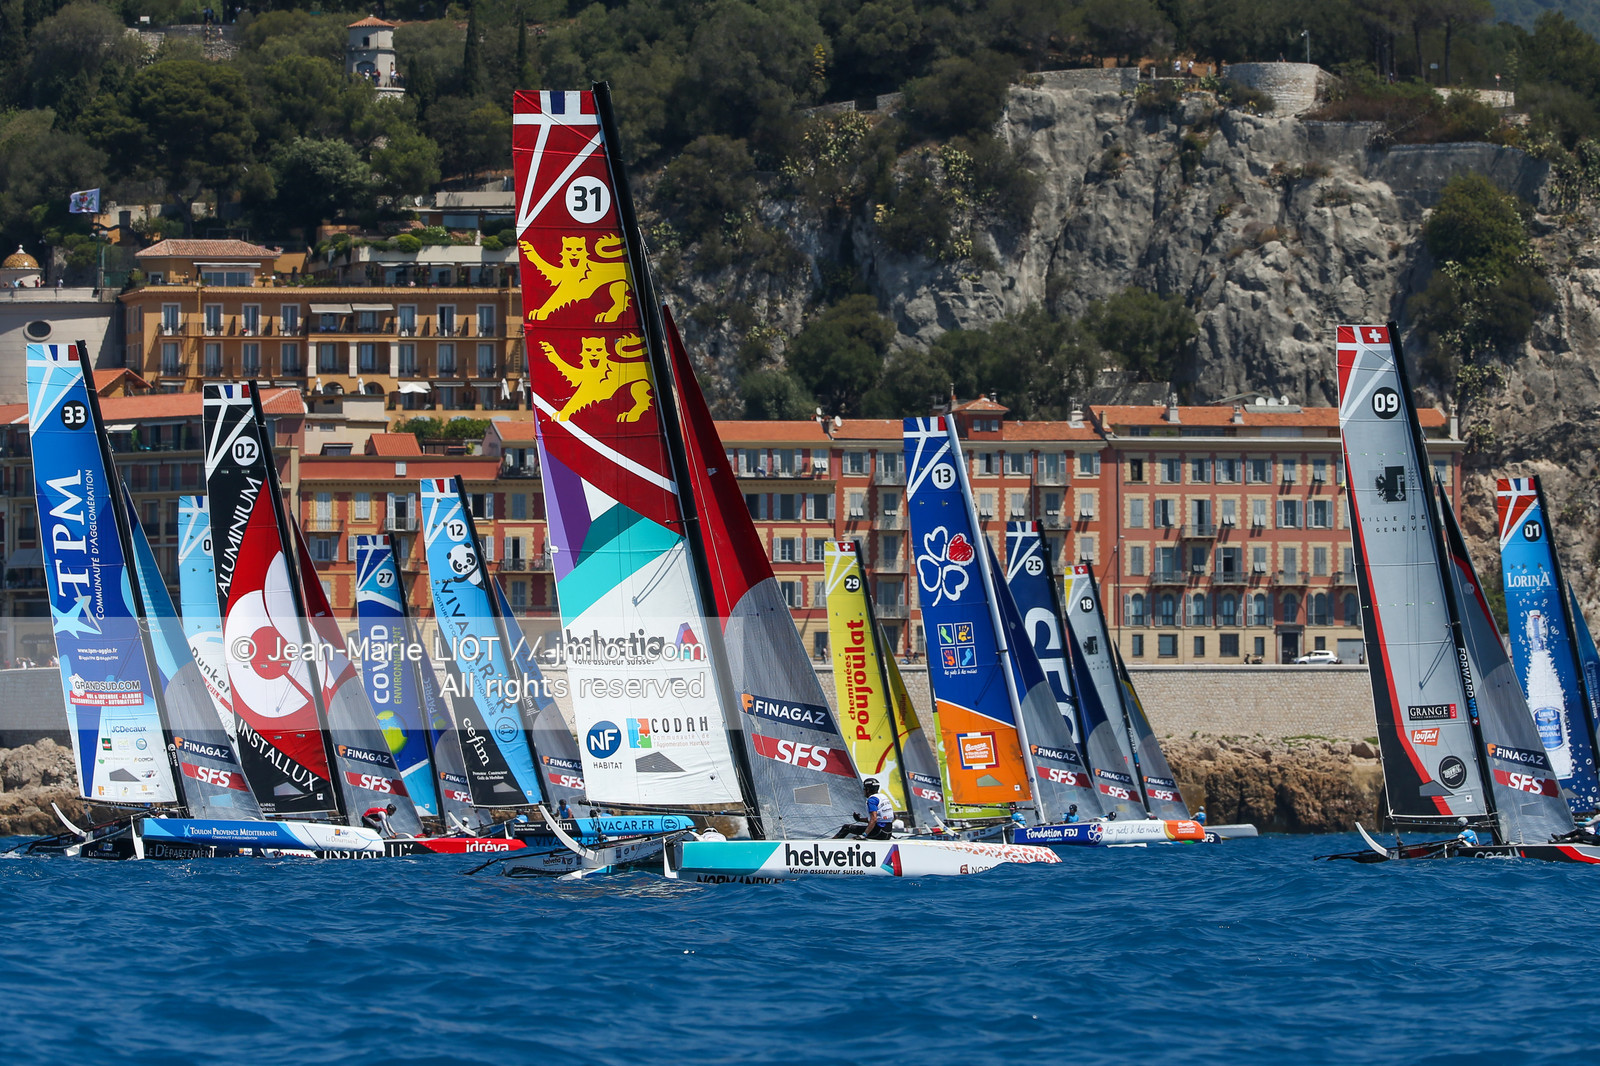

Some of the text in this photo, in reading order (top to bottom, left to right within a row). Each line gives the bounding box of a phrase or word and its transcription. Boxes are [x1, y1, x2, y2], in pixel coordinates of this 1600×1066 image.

[573, 186, 601, 211] 31
[1374, 393, 1399, 412] 09
[64, 406, 85, 423] 33
[235, 443, 256, 459] 02
[935, 468, 951, 483] 13
[46, 470, 90, 596] TPM
[449, 524, 464, 536] 12
[1376, 524, 1427, 533] GENÈVE
[1524, 524, 1540, 537] 01
[218, 477, 262, 597] ALUMINIUM
[1028, 560, 1041, 570] 25
[378, 573, 392, 583] 27
[845, 578, 860, 589] 29
[1507, 571, 1552, 587] LORINA
[1081, 600, 1093, 609] 18
[844, 619, 873, 741] Poujoulat
[1457, 647, 1473, 698] FORWARD
[75, 680, 140, 691] GRANDSUD.COM
[845, 655, 856, 720] cheminées
[755, 700, 826, 725] FINAGAZ
[1409, 706, 1448, 716] GRANGE
[112, 725, 146, 733] JCDecaux
[651, 716, 709, 734] CODAH
[463, 717, 490, 767] cefim
[590, 728, 618, 751] NF
[184, 741, 229, 759] FINAGAZ
[237, 718, 320, 792] INSTALLUX
[347, 748, 390, 764] FINAGAZ
[774, 739, 831, 772] SFS
[1038, 749, 1076, 762] FINAGAZ
[1496, 748, 1544, 765] FINAGAZ
[196, 766, 232, 788] SFS
[359, 774, 392, 794] SFS
[560, 774, 584, 790] SFS
[1048, 768, 1078, 785] SFS
[1100, 771, 1131, 783] FINAGAZ
[1148, 777, 1173, 786] FINAGAZ
[1508, 772, 1546, 795] SFS
[921, 788, 942, 802] SFS
[1108, 786, 1130, 800] SFS
[1154, 790, 1173, 801] SFS
[190, 827, 212, 835] TOULON
[212, 827, 239, 836] PROVENCE
[546, 820, 573, 831] cfim
[1026, 828, 1079, 839] Fondation FDJ
[466, 840, 509, 853] idréva
[785, 843, 876, 867] helvetia
[789, 867, 809, 875] Votre
